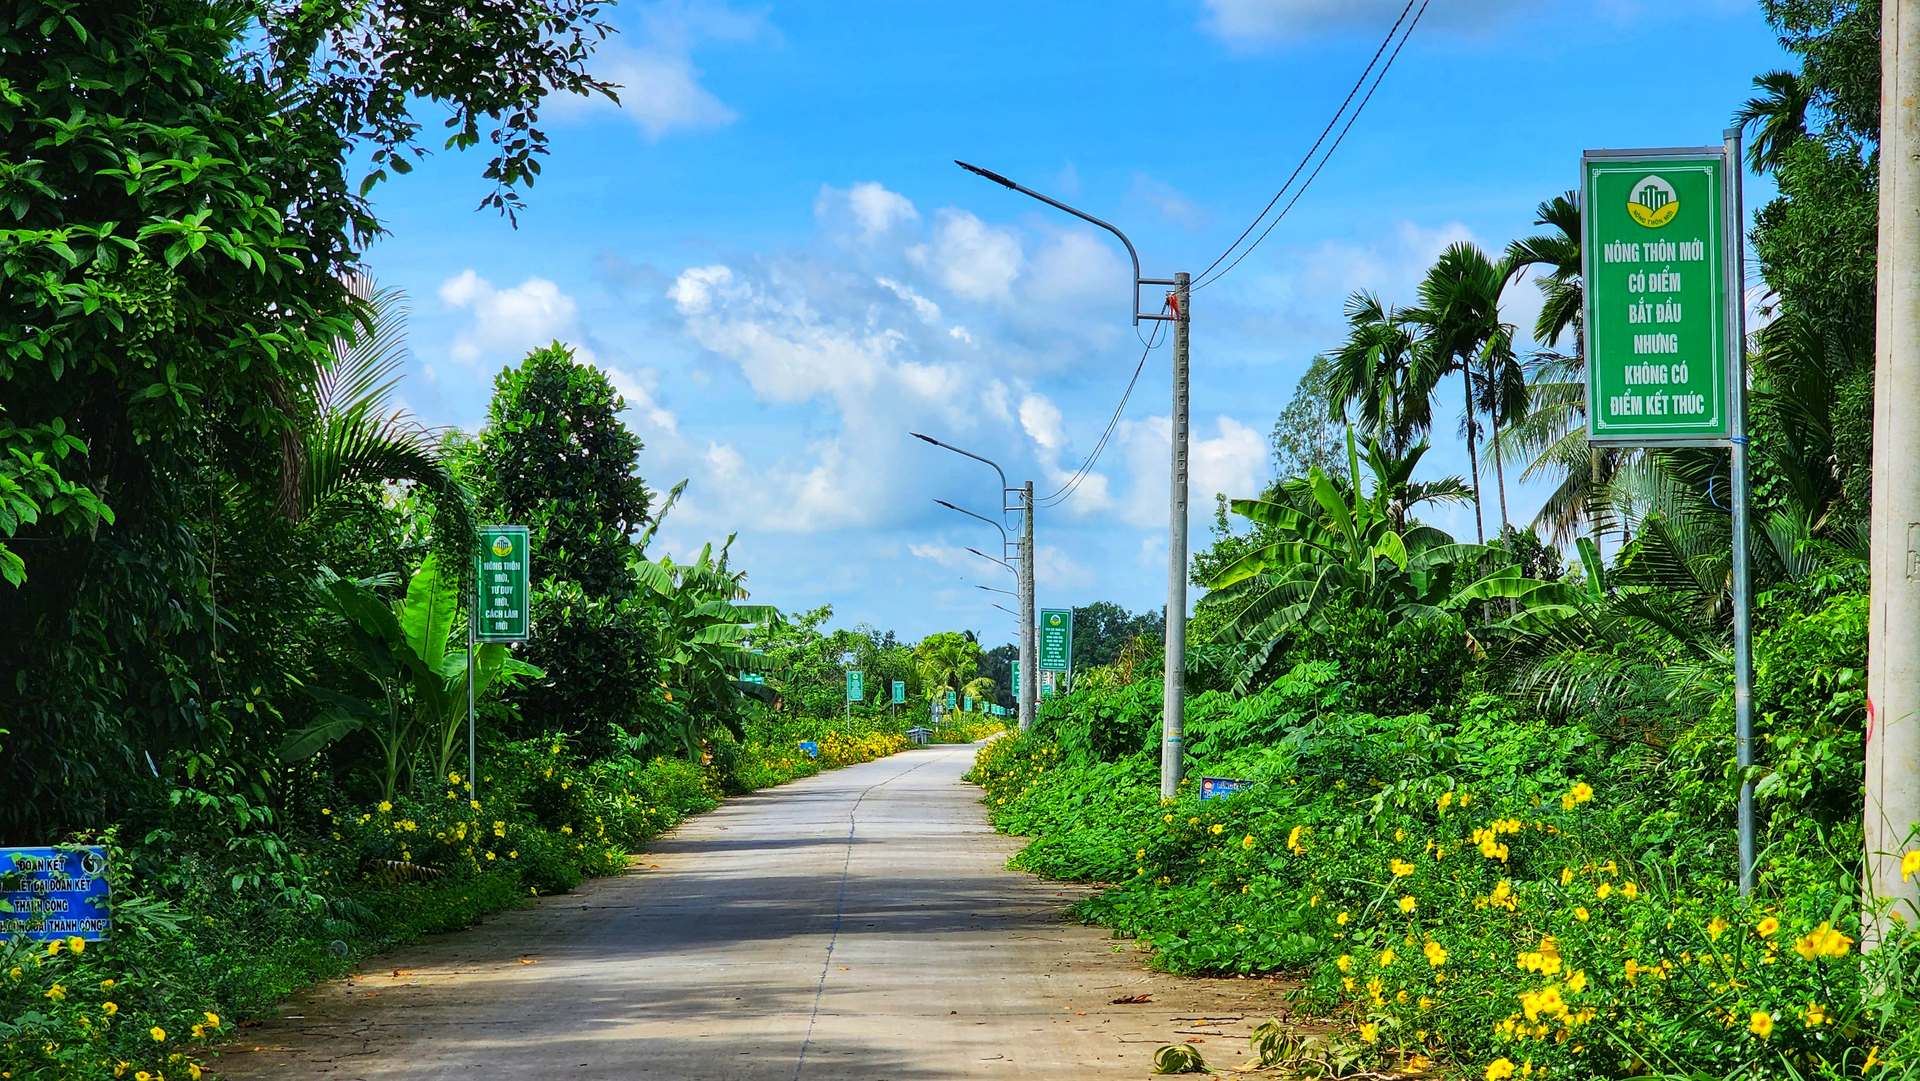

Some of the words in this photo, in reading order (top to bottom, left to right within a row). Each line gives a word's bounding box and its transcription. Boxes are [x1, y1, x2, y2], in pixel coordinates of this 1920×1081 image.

[1604, 239, 1639, 262] NÔNG
[1643, 238, 1676, 262] THÔN
[1679, 237, 1704, 261] MỚI
[1628, 269, 1645, 293] CÓ
[1648, 264, 1681, 292] ĐIỂM
[1629, 296, 1653, 324] BẮT
[1656, 296, 1681, 323] ĐẦU
[1633, 332, 1678, 354] NHƯNG
[1624, 361, 1668, 384] KHÔNG
[1671, 360, 1688, 384] CÓ
[1610, 388, 1642, 415] ĐIỂM
[1646, 389, 1668, 415] KẾT
[1672, 390, 1704, 414] THÚC
[484, 561, 502, 570] NÔNG
[503, 561, 520, 570] THÔN
[491, 585, 500, 595] TƯ
[500, 586, 513, 595] DUY
[485, 609, 503, 618] CÁCH
[504, 609, 518, 618] LÀM
[495, 621, 508, 630] MỚI
[74, 874, 91, 892] KẾT
[49, 916, 77, 932] THÀNH
